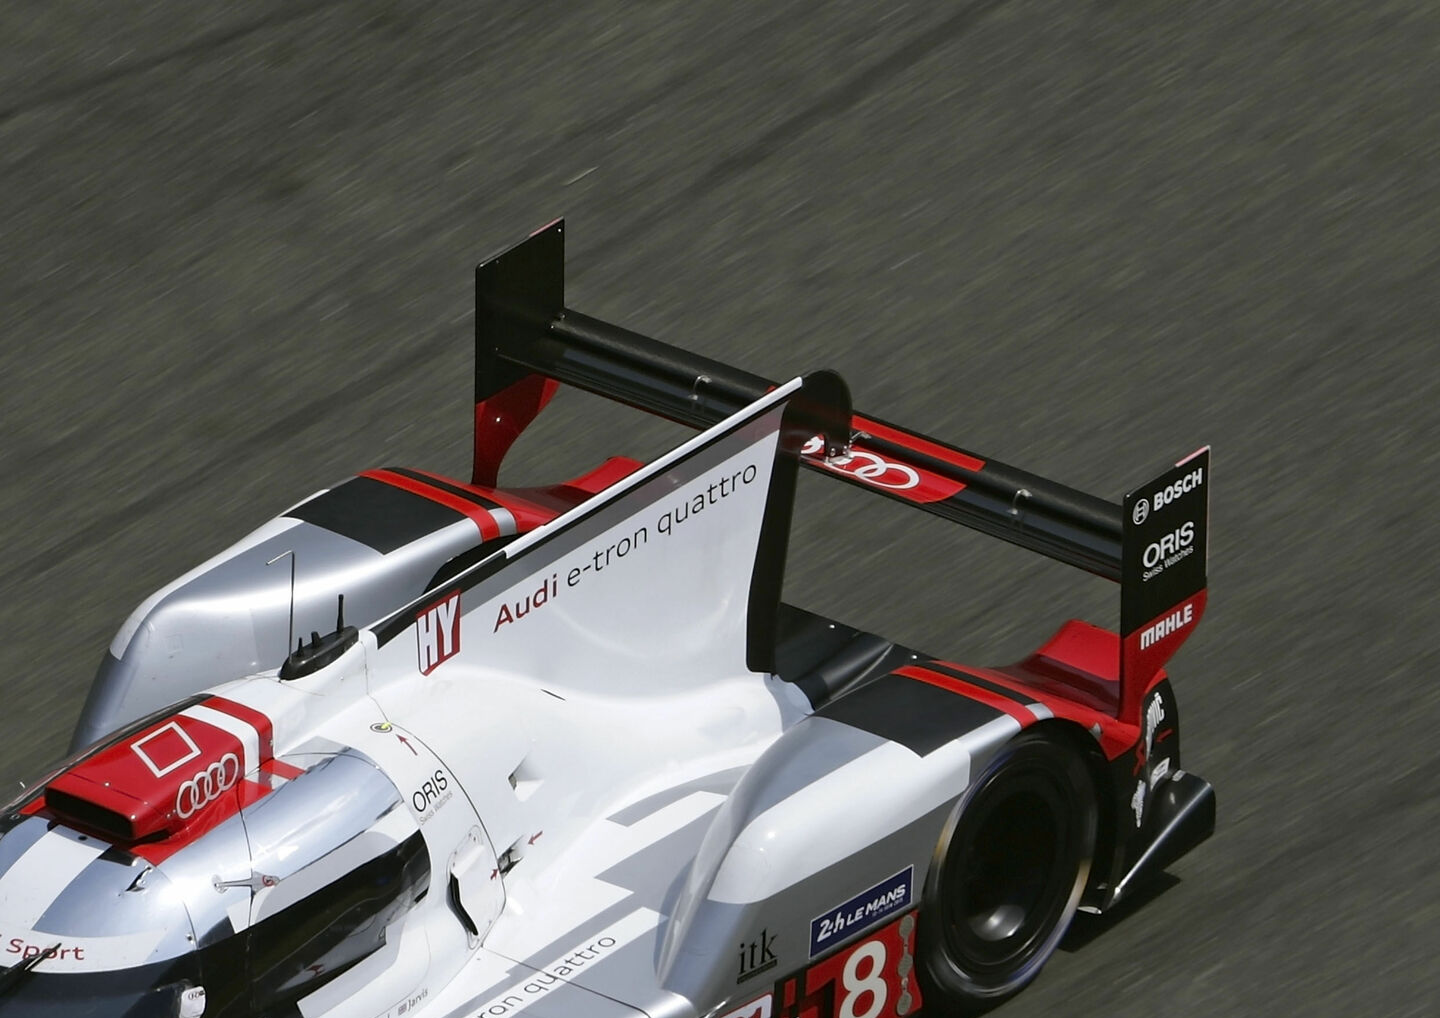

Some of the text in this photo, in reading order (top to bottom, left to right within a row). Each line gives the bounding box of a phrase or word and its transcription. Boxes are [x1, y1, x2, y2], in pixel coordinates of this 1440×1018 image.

[1153, 468, 1203, 511] BOSCH
[494, 463, 757, 633] Audi e-tron quattro
[1143, 521, 1195, 568] ORIS
[1143, 546, 1194, 582] Swiss Watches
[417, 594, 459, 674] HY
[1140, 604, 1193, 651] MAHLE
[412, 770, 448, 812] ORIS
[846, 907, 865, 926] LE
[865, 884, 906, 915] MANS
[6, 938, 85, 961] Sport
[524, 936, 617, 994] quattro
[739, 928, 778, 976] itk
[408, 988, 429, 1012] Jarvis
